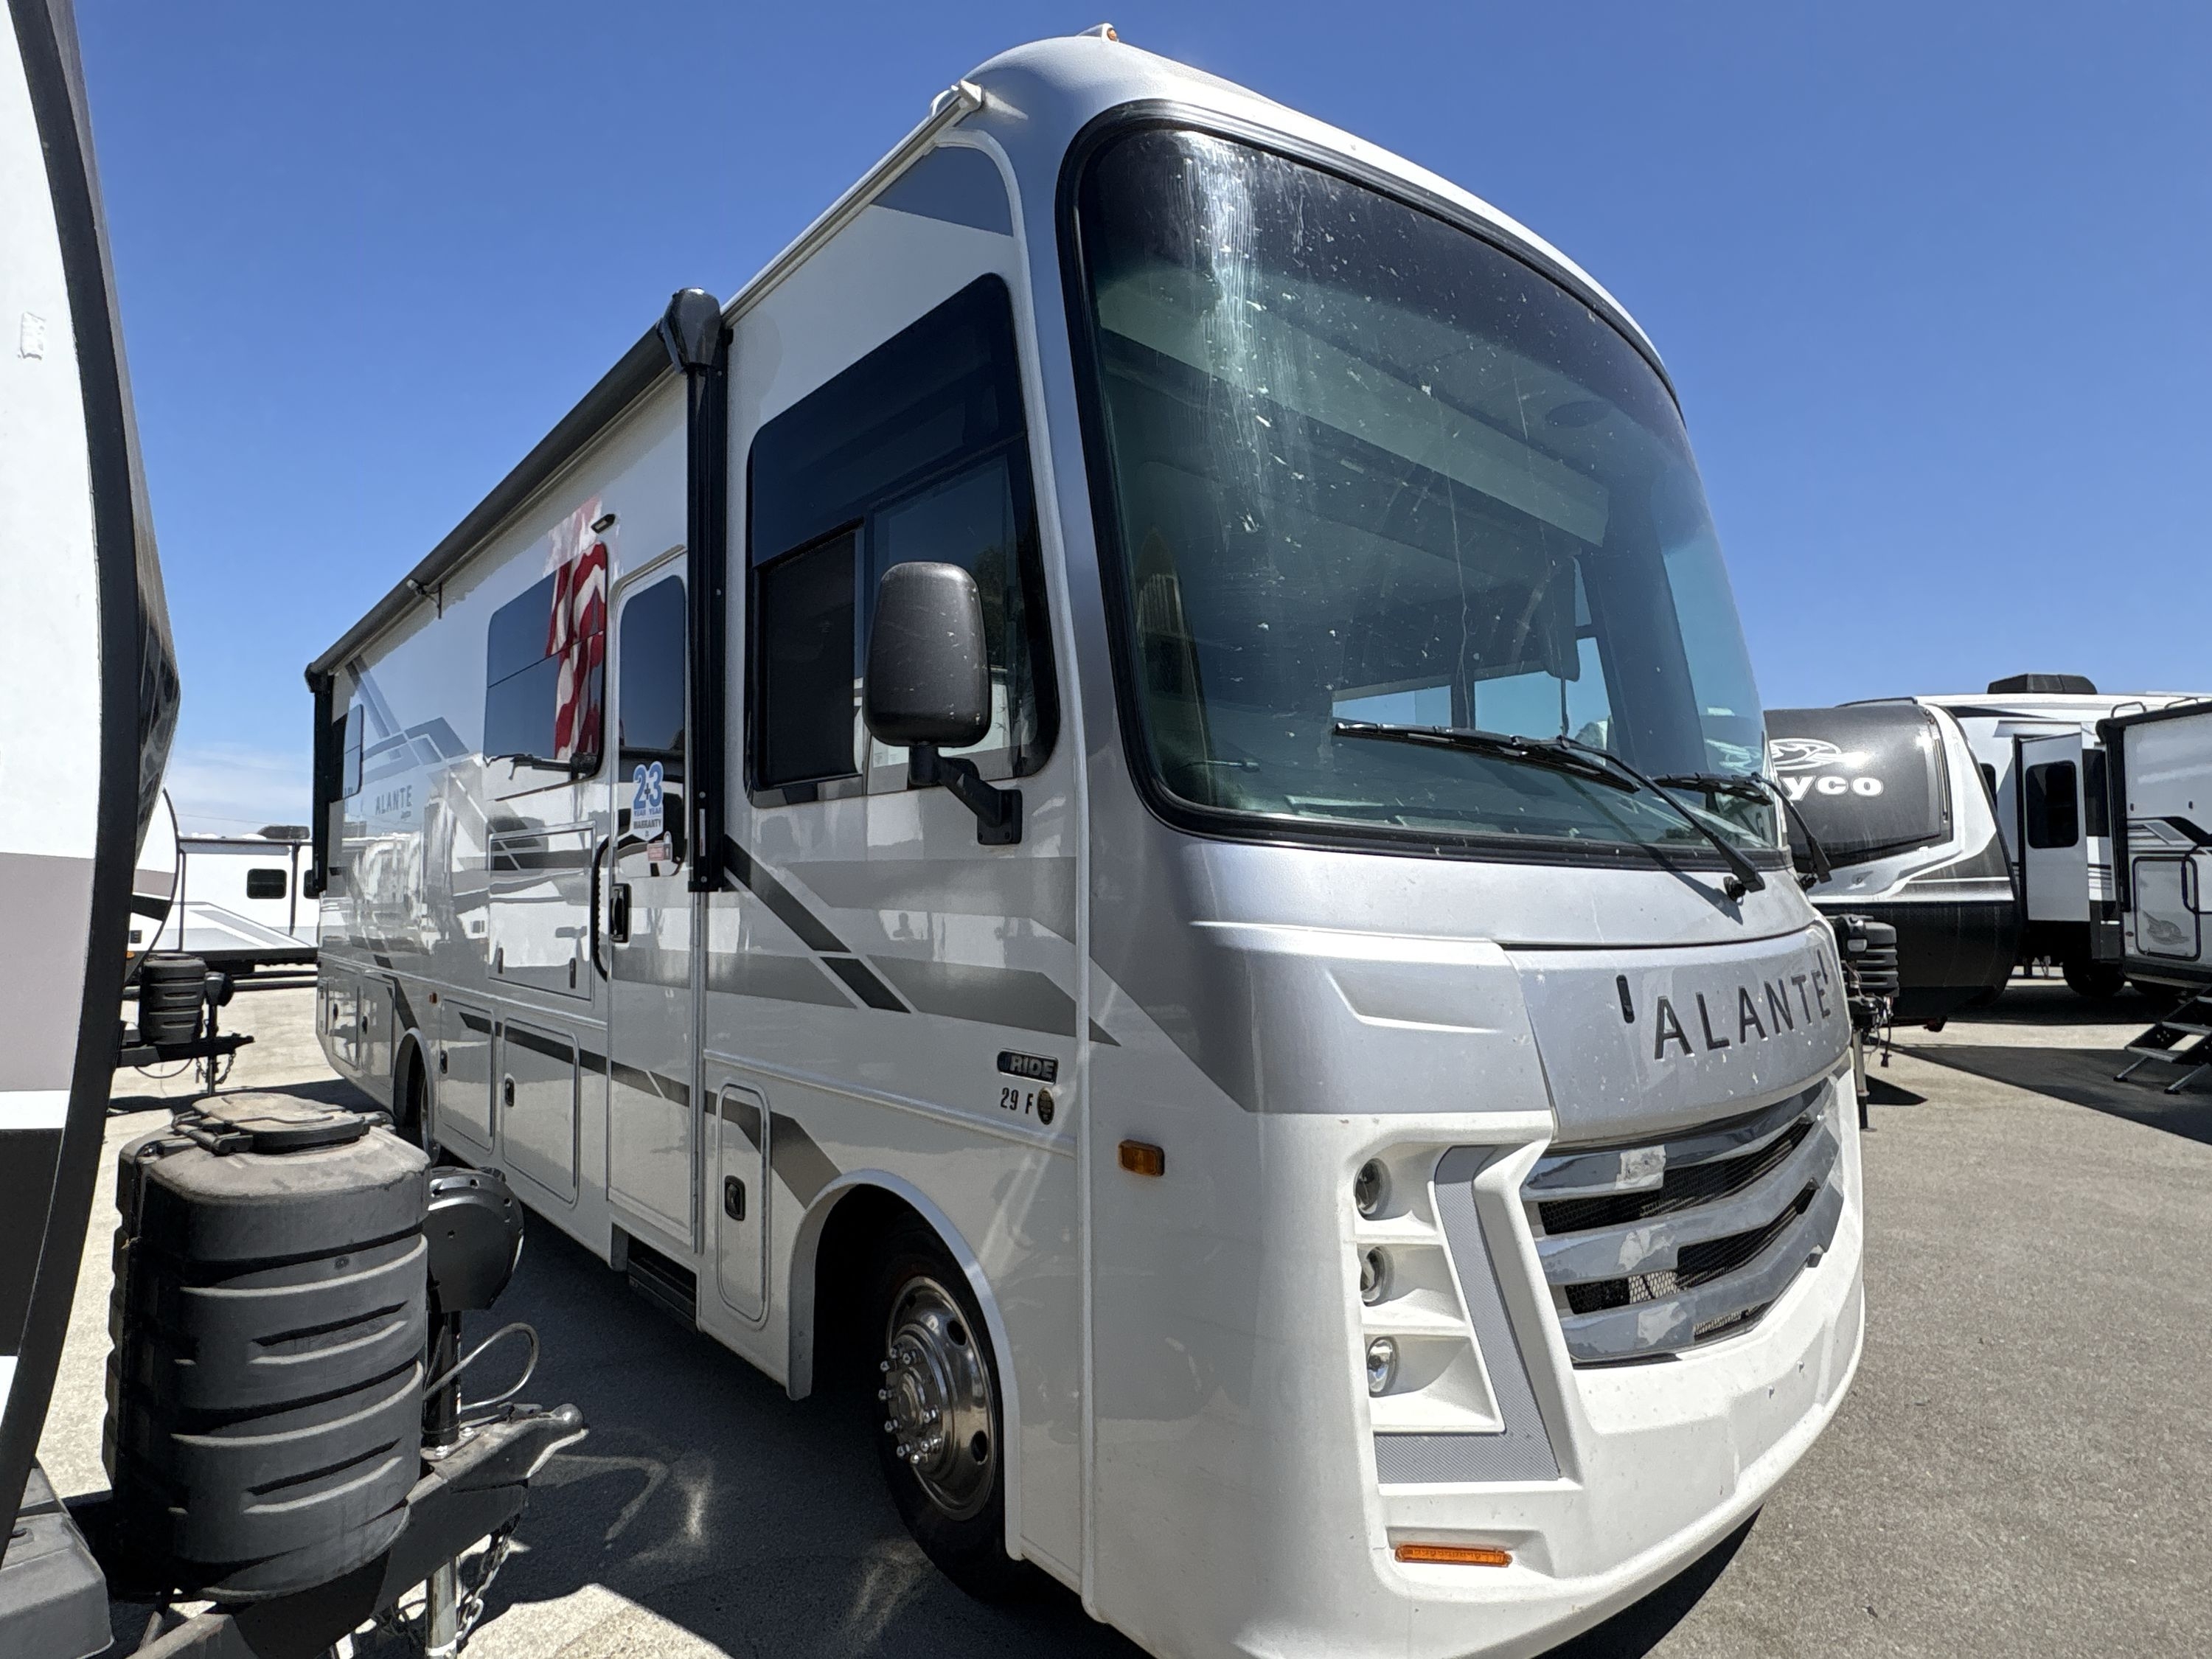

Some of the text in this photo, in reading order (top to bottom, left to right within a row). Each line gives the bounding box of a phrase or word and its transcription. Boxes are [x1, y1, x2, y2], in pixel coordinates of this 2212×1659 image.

[375, 785, 412, 815] ALANTE
[633, 818, 662, 830] WARRANTY
[1654, 969, 1832, 1060] ALANTE
[1000, 1087, 1019, 1110] 29
[1025, 1093, 1034, 1114] F
